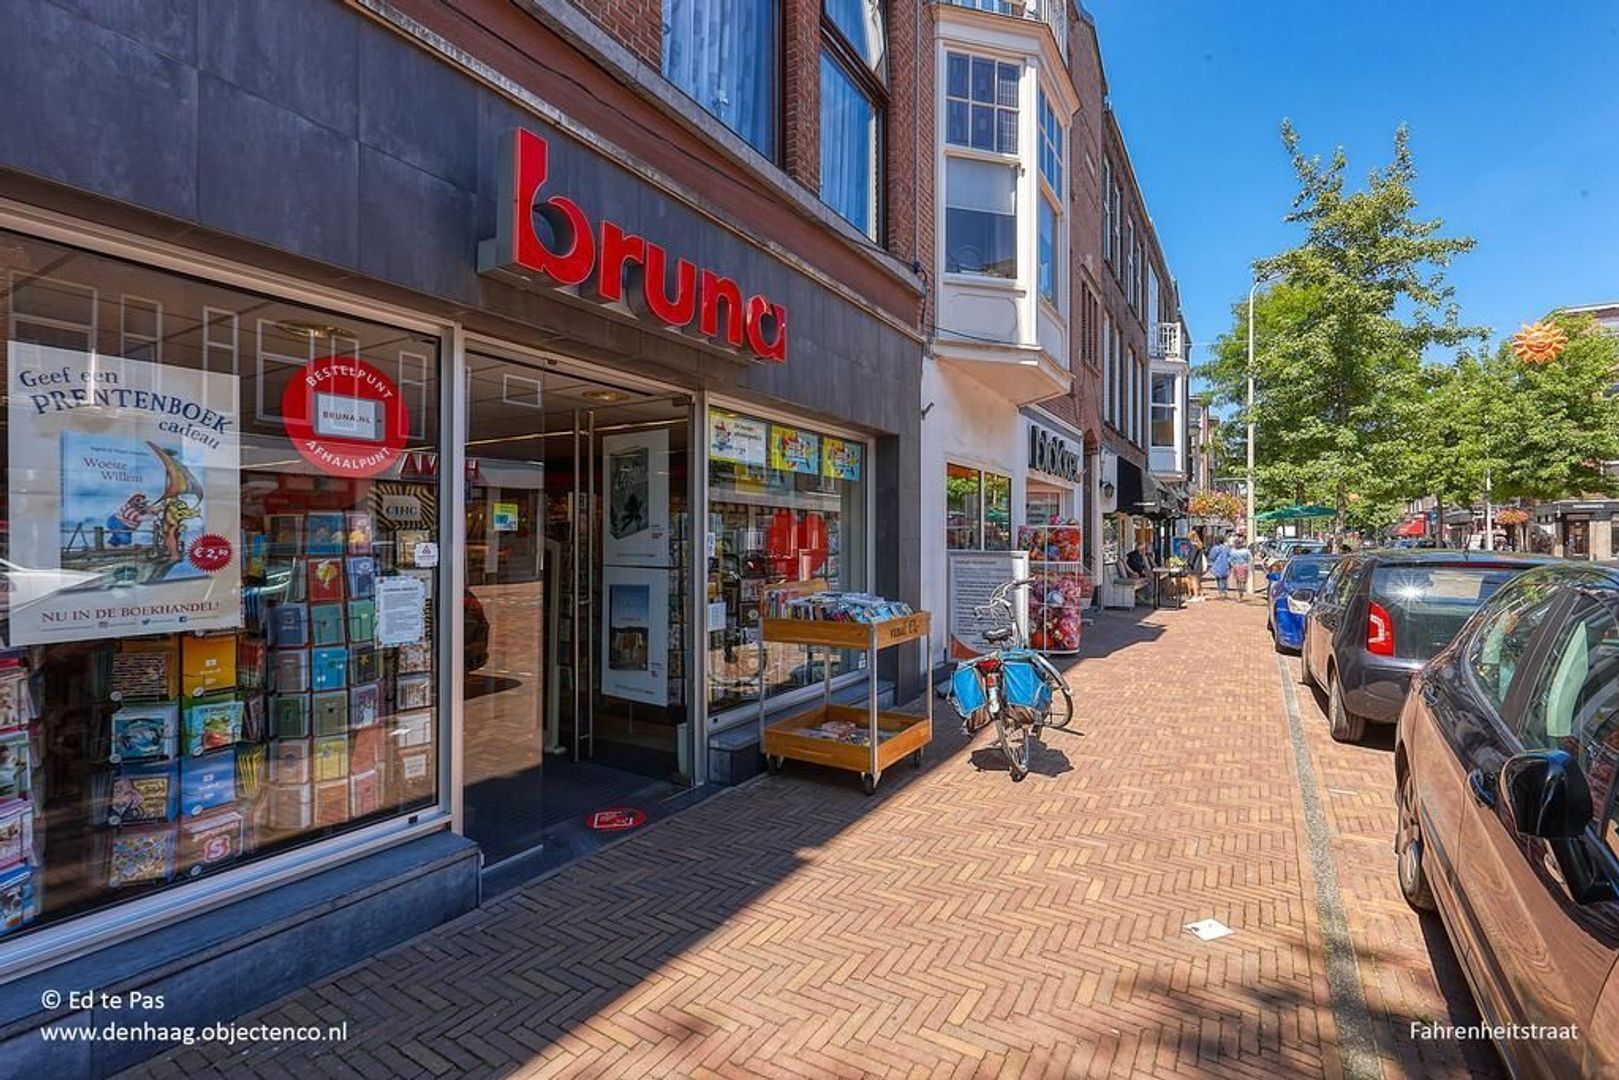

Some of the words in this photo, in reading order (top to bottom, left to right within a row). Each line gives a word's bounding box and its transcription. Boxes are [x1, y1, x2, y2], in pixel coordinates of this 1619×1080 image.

[512, 126, 787, 363] bruna
[19, 367, 71, 387] Geef
[80, 370, 118, 384] een
[305, 365, 393, 399] BESTELPUNT
[31, 388, 234, 434] PRENTENBOEK
[322, 411, 371, 425] BRUNA.NL
[158, 418, 221, 449] cadeau
[83, 456, 128, 471] Woeste
[305, 440, 391, 469] AFHAALPUNT
[101, 471, 142, 482] Willem
[42, 611, 68, 622] NU
[73, 609, 90, 621] IN
[96, 607, 116, 619] DE
[121, 601, 220, 617] BOEKHANDEL!
